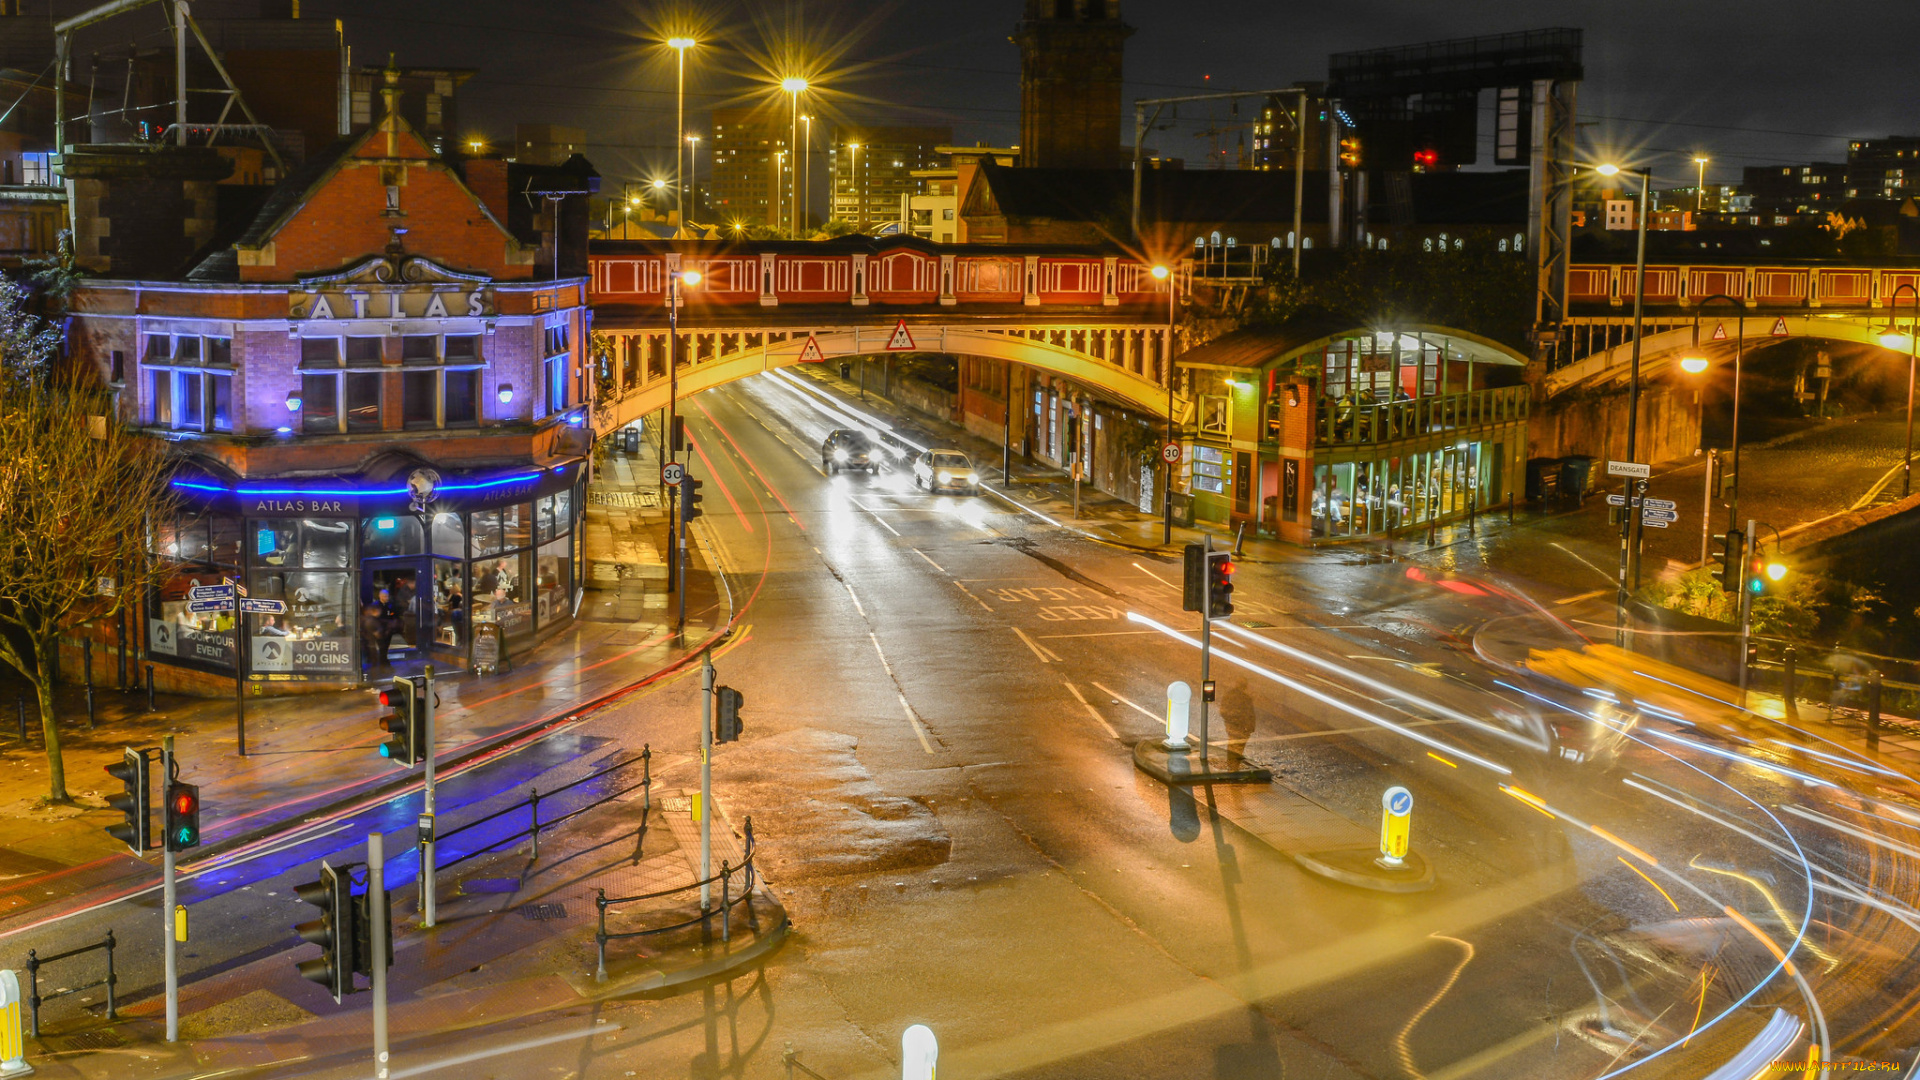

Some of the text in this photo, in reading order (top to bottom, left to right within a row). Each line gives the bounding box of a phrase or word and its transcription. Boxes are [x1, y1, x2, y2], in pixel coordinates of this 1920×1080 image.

[310, 292, 484, 319] ATLAS
[1165, 448, 1179, 458] 30
[665, 469, 681, 479] 30
[1610, 464, 1648, 475] DEANSGATE
[483, 484, 533, 503] ATLAS BAR
[256, 500, 342, 512] ATLAS BAR
[1036, 605, 1128, 621] KEEP
[211, 635, 235, 648] YOUR
[305, 641, 340, 652] OVER
[196, 643, 223, 658] EVENT
[295, 653, 350, 664] 300 GINS
